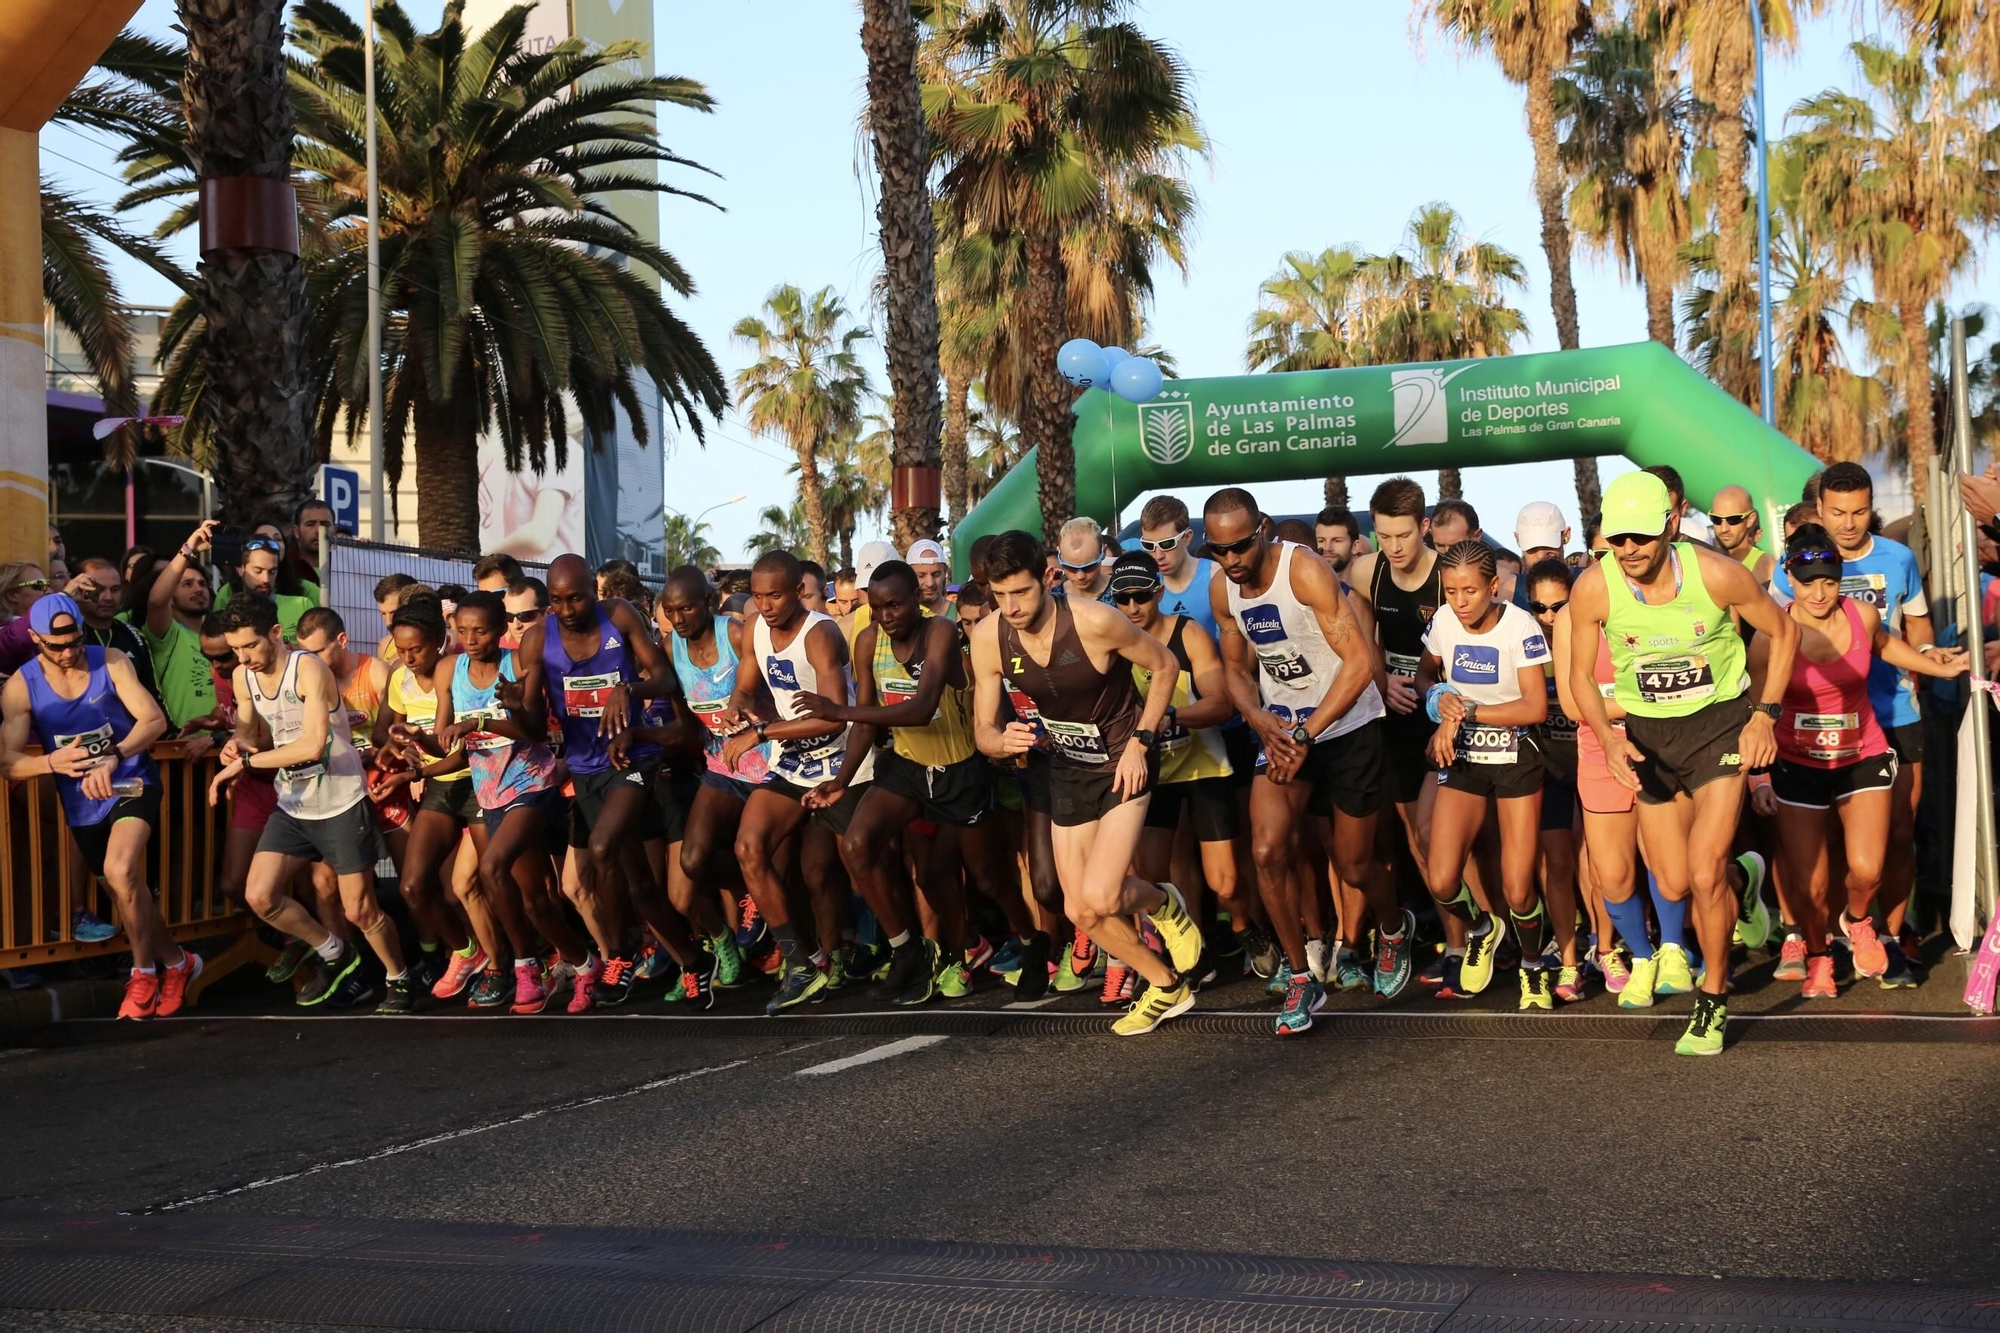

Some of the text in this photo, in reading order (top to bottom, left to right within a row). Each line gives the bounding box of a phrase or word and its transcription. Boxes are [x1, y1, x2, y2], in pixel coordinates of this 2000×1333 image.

[1460, 375, 1622, 402] Instituto Municipal
[1205, 395, 1355, 420] Ayuntamiento
[1461, 402, 1569, 422] de Deportes
[1206, 414, 1357, 437] de Las Palmas
[1461, 415, 1621, 437] Las Palmas de Gran Canaria
[1208, 432, 1358, 456] de Gran Canaria
[331, 477, 352, 524] P
[1246, 617, 1281, 633] Emicela
[1648, 636, 1680, 648] sports
[1454, 652, 1497, 674] Emicela
[1645, 668, 1703, 689] 4737
[590, 690, 599, 703] 1
[711, 713, 722, 725] 6
[1052, 731, 1099, 750] 3004
[1463, 730, 1512, 748] 3008
[1815, 731, 1840, 747] 68
